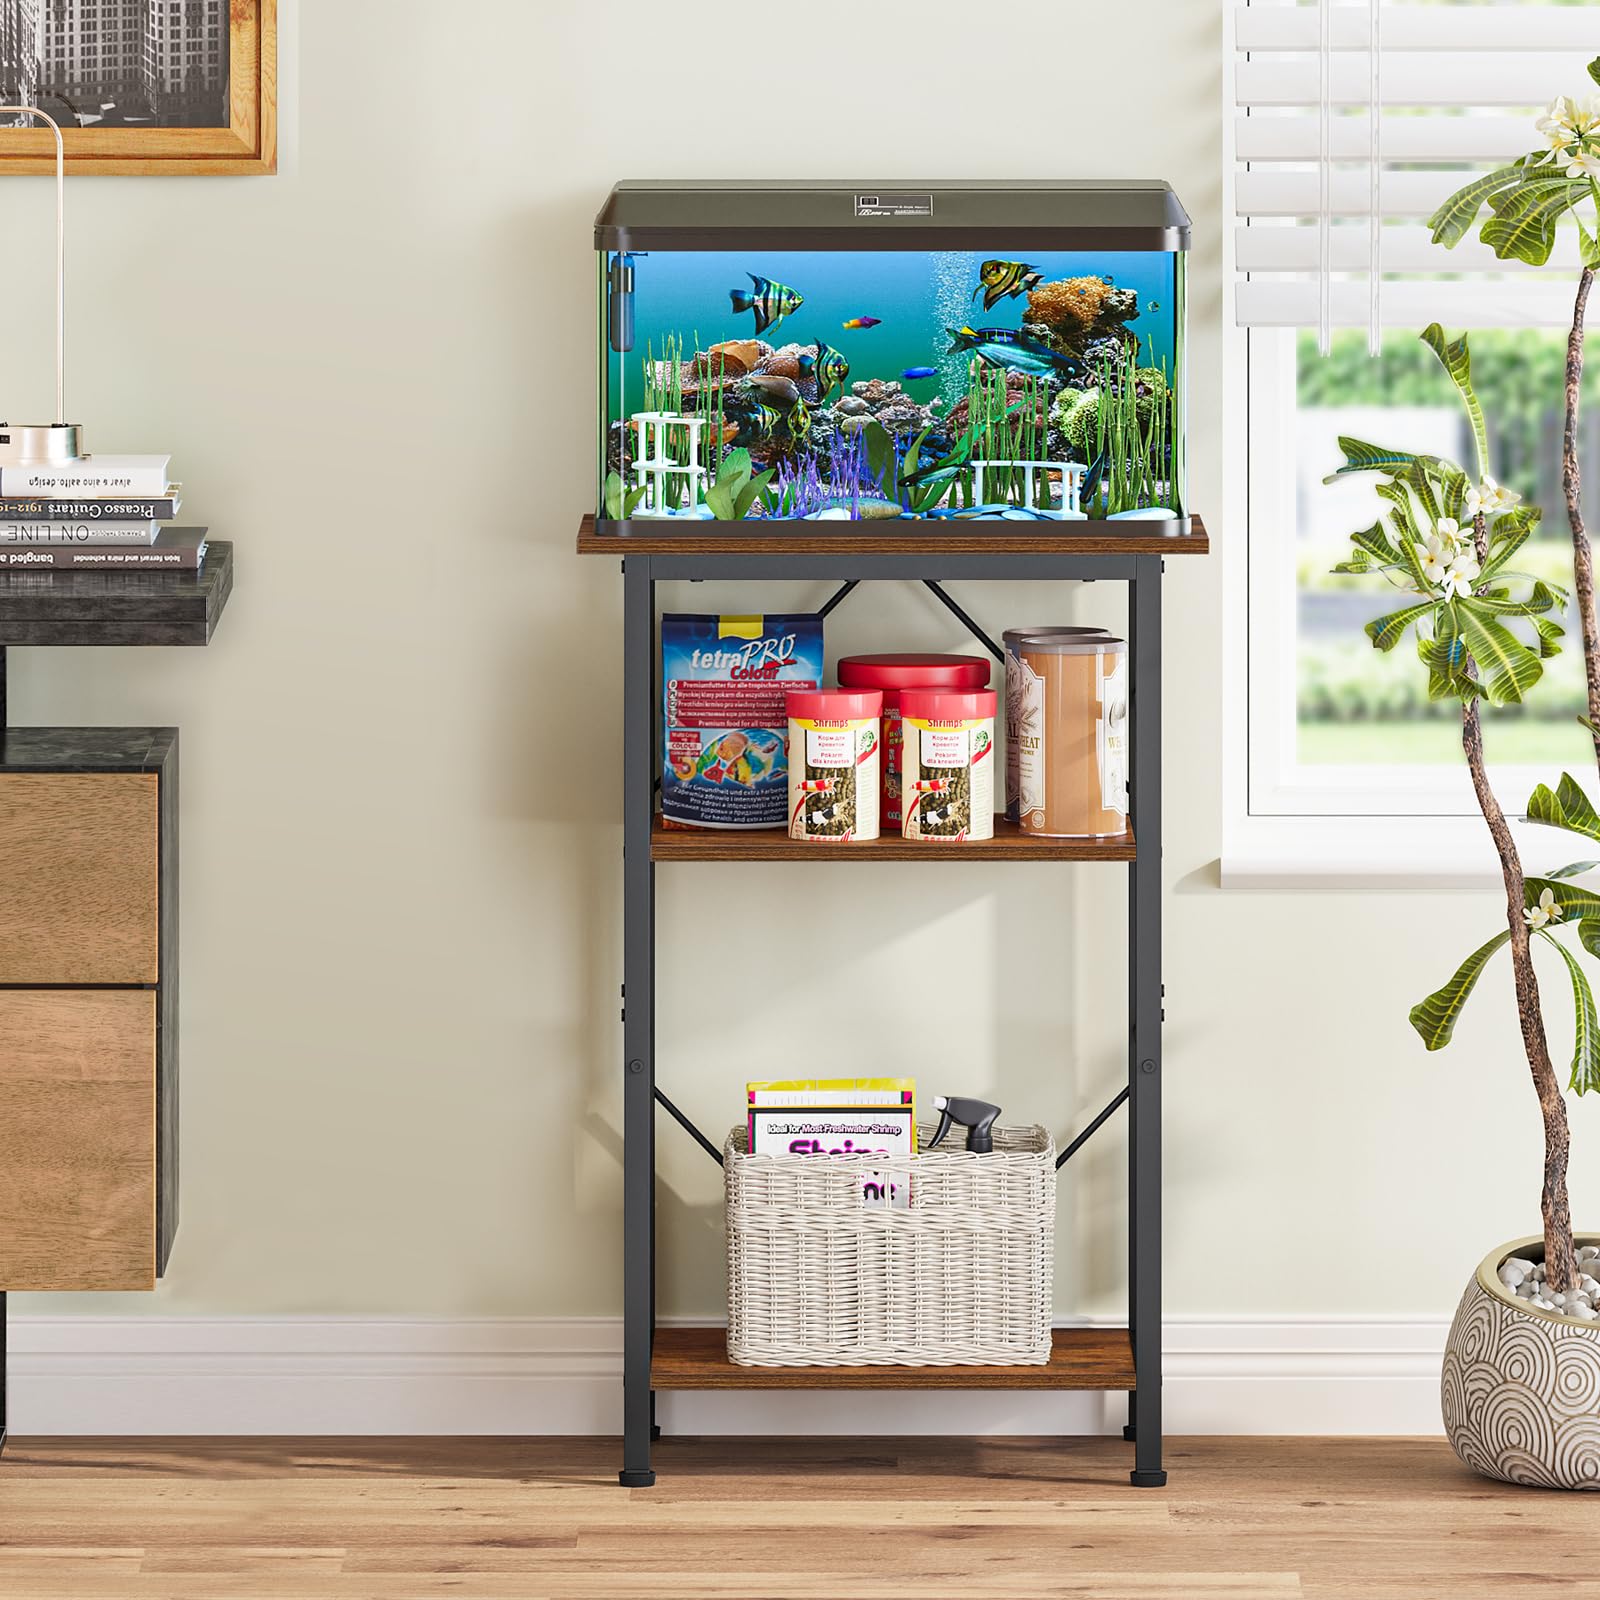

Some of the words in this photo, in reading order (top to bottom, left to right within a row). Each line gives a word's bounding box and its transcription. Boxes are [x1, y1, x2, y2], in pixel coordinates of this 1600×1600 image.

[83, 479, 101, 488] aino
[110, 479, 131, 488] alvar
[48, 504, 102, 518] Guitars
[105, 504, 155, 518] Picasso
[8, 525, 51, 541] LINE
[61, 525, 89, 541] ON
[730, 665, 780, 680] Colour
[813, 719, 848, 728] Shrimps
[928, 719, 963, 728] Shrimps
[767, 1124, 788, 1134] Ideal
[788, 1124, 801, 1134] for
[801, 1124, 824, 1134] Most
[824, 1124, 870, 1134] Freshwater
[870, 1124, 902, 1137] Shrimp
